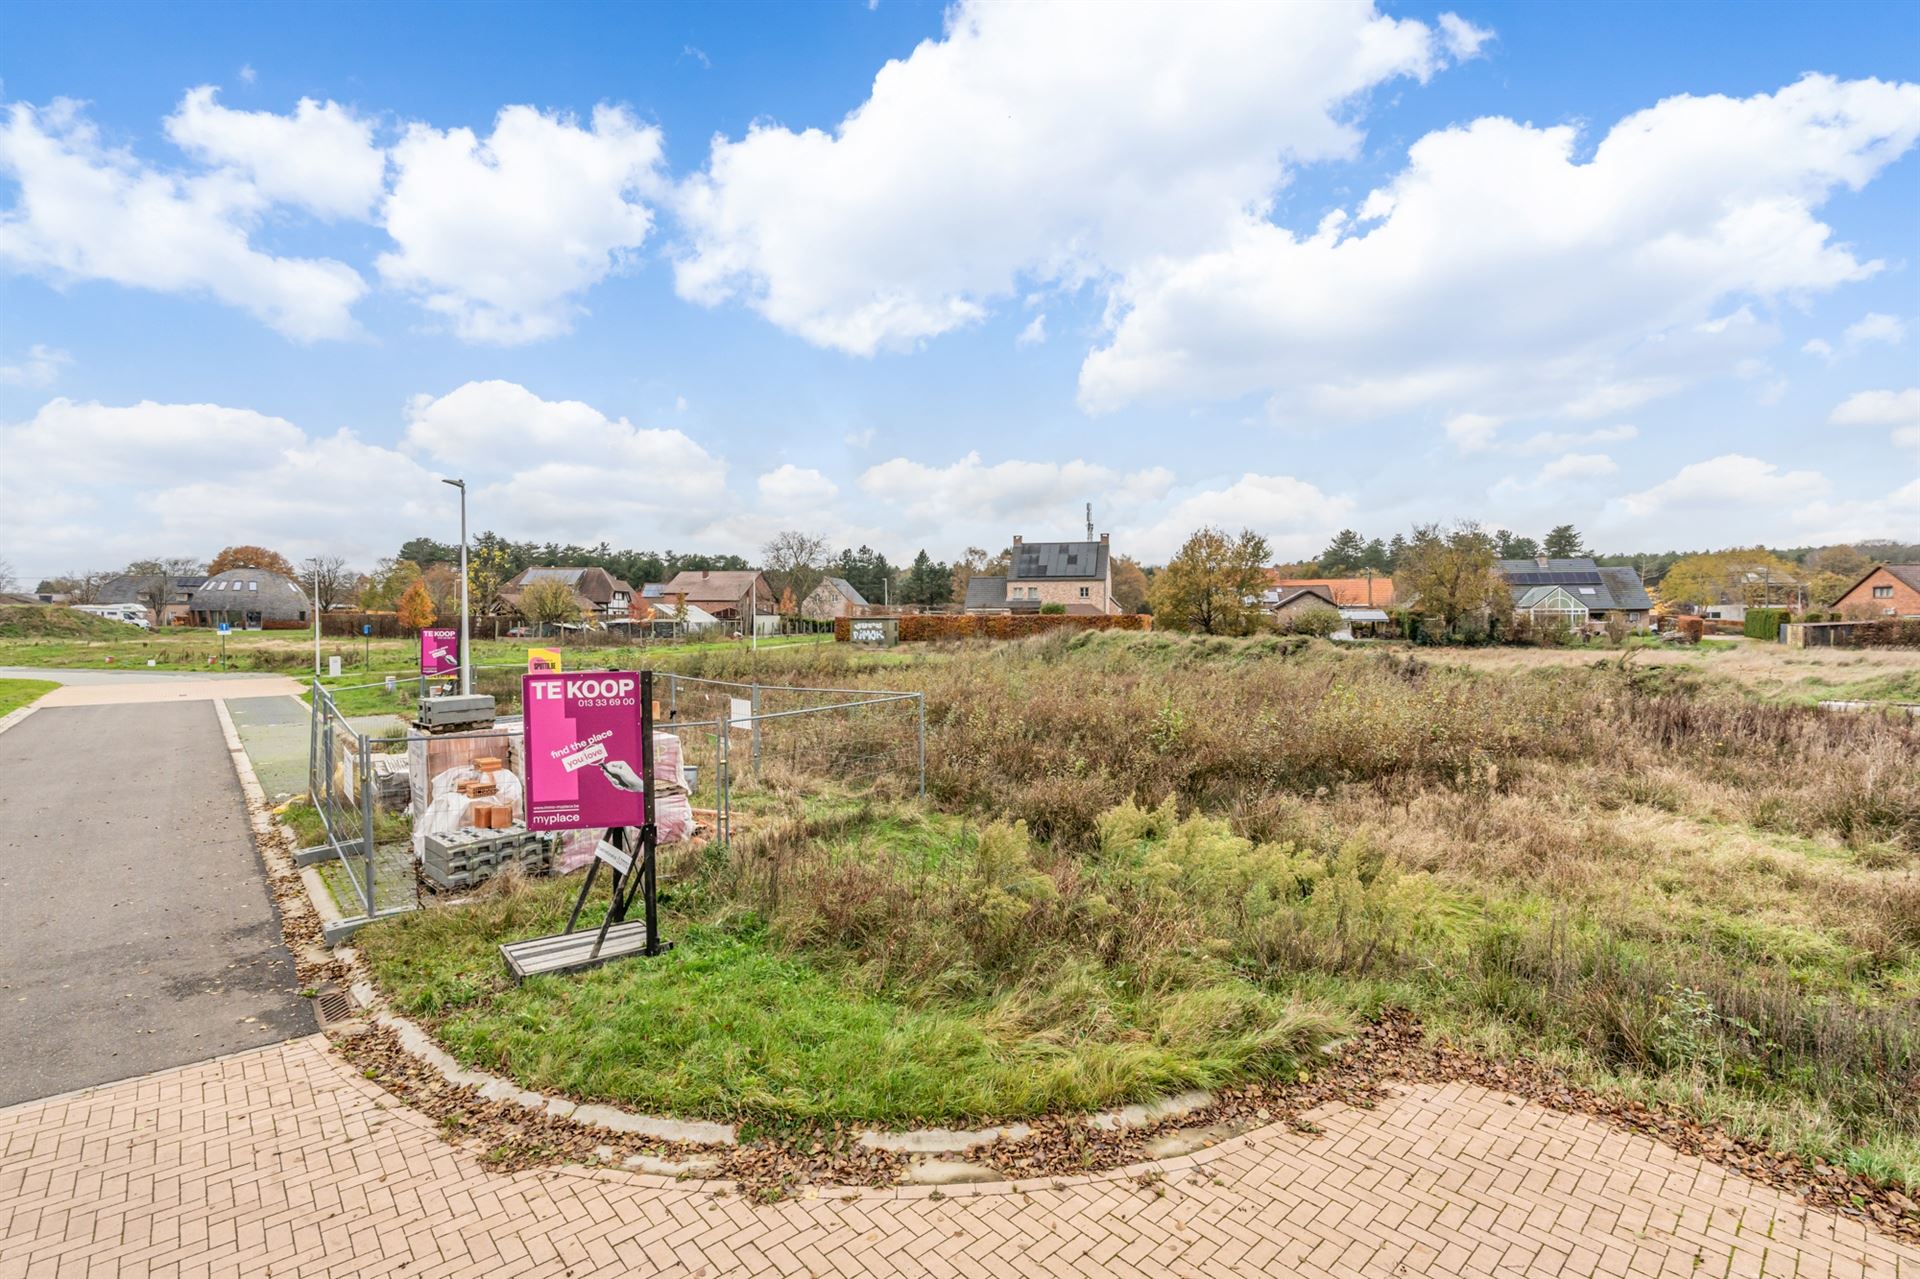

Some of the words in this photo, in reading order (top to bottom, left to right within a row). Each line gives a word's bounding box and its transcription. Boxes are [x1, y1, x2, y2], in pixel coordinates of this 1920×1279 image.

[530, 681, 562, 700] TE
[567, 679, 635, 699] KOOP
[578, 699, 593, 708] 013
[595, 698, 607, 707] 33
[609, 698, 621, 706] 69
[622, 698, 635, 706] 00
[550, 746, 570, 760] find
[570, 739, 588, 752] the
[587, 729, 614, 746] place
[566, 756, 585, 769] you
[584, 748, 603, 760] love
[533, 813, 580, 826] myplace
